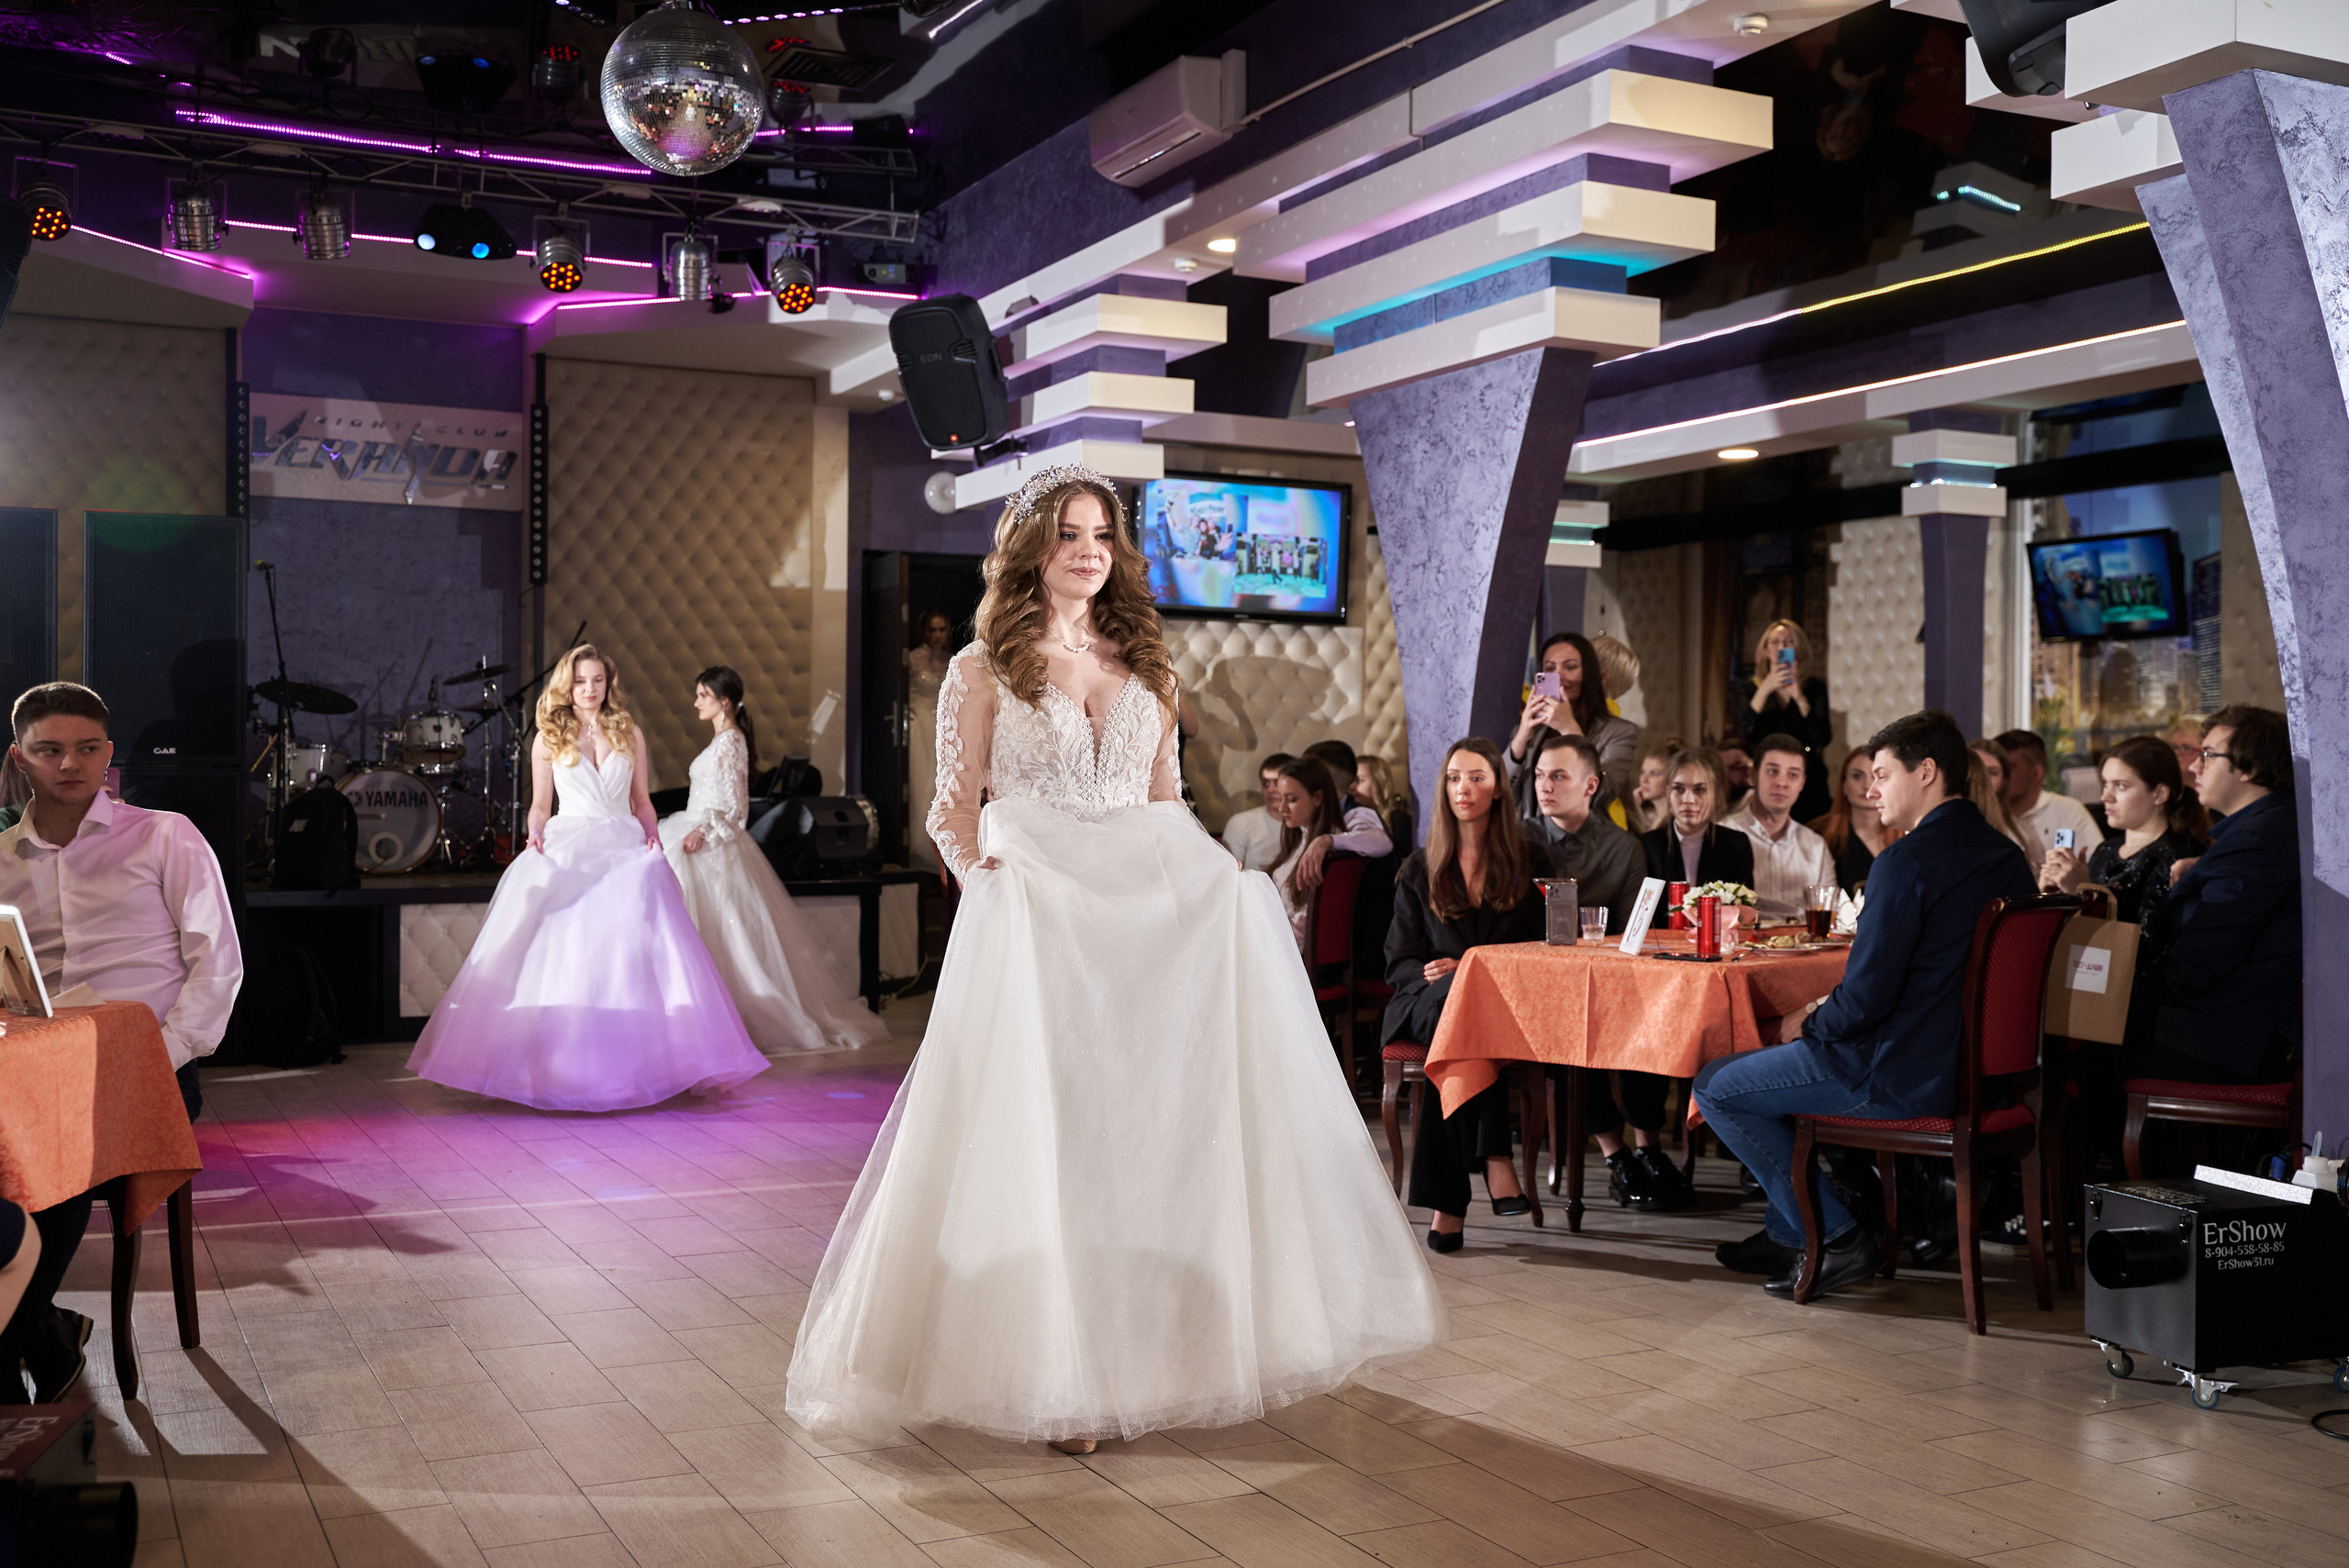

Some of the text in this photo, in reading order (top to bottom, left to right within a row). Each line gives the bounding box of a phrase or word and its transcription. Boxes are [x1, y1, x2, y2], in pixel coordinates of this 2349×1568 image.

[919, 352, 942, 363] EON
[312, 416, 507, 438] NIGHT CLUB
[250, 410, 519, 504] VERANDA
[365, 790, 429, 807] YAMAHA
[2203, 1219, 2287, 1245] ErShow
[2205, 1240, 2285, 1259] 8-904-538-58-85
[2218, 1256, 2275, 1270] ErShow31.ru
